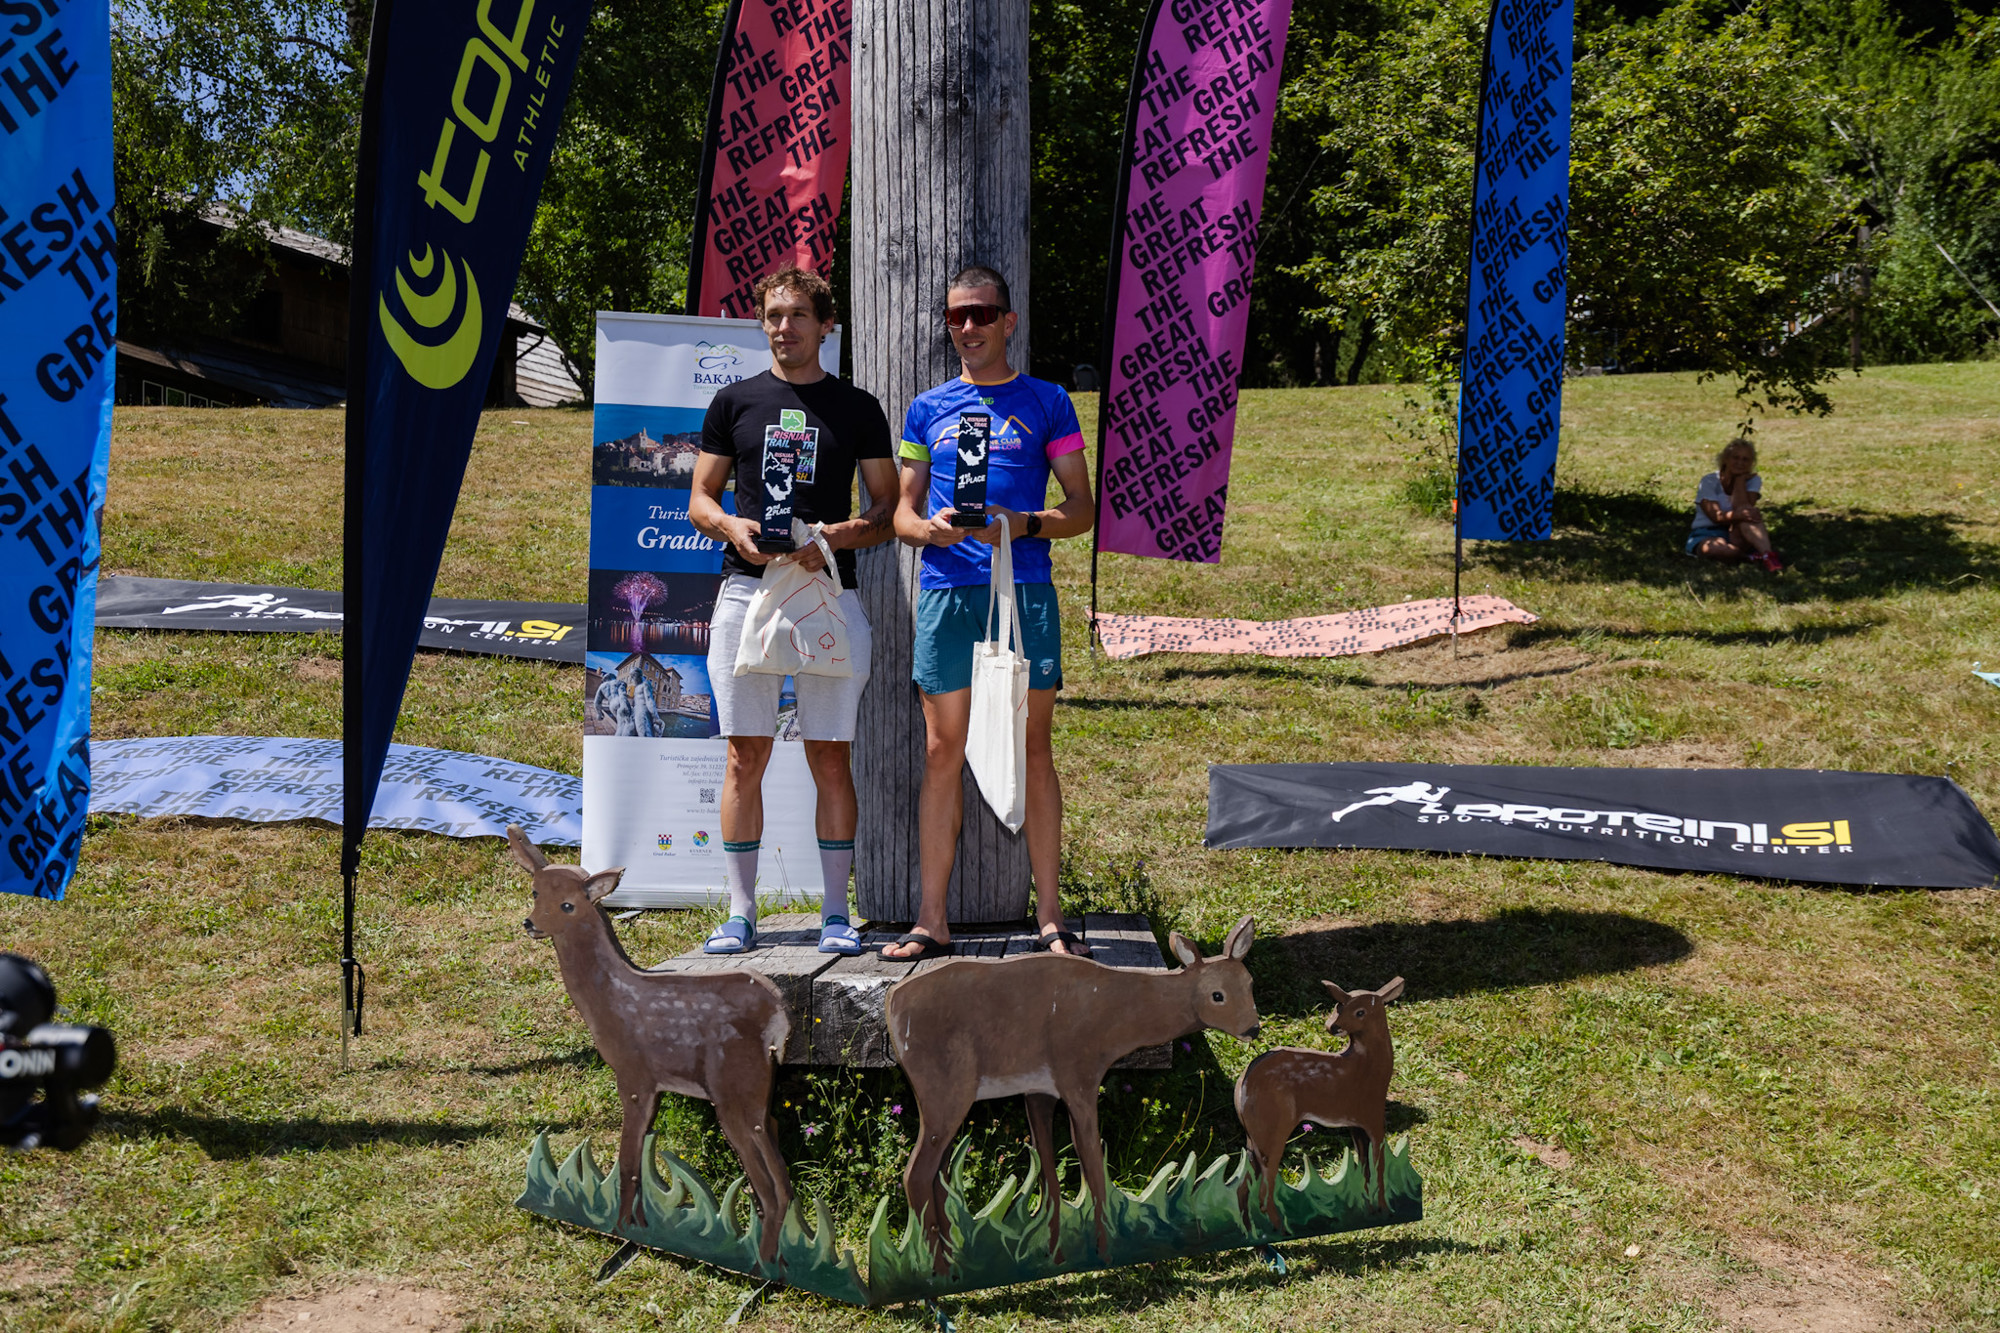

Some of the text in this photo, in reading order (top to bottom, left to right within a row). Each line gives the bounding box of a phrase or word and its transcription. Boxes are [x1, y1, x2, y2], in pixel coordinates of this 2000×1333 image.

[799, 0, 852, 51] THE
[1213, 11, 1271, 64] THE
[1522, 26, 1555, 73] THE
[513, 15, 566, 173] ATHLETIC
[727, 49, 784, 101] THE
[1140, 65, 1197, 118] THE
[1193, 39, 1275, 116] GREAT
[1485, 70, 1515, 118] THE
[1511, 50, 1565, 120] GREAT
[726, 78, 841, 177] REFRESH
[786, 117, 838, 171] THE
[1140, 88, 1261, 191] REFRESH
[1202, 127, 1259, 180] THE
[1484, 96, 1558, 188] REFRESH
[1515, 130, 1561, 180] THE
[709, 176, 758, 228] THE
[713, 185, 792, 256] GREAT
[1124, 191, 1172, 242] THE
[1473, 189, 1501, 237] THE
[725, 192, 834, 285] REFRESH
[1129, 196, 1210, 269] GREAT
[1140, 199, 1254, 298] REFRESH
[1475, 196, 1525, 265] GREAT
[1481, 193, 1566, 290] REFRESH
[1134, 284, 1190, 334] THE
[1478, 278, 1515, 325] THE
[1119, 309, 1197, 381] GREAT
[1468, 300, 1527, 371] GREAT
[1522, 333, 1564, 383] THE
[1106, 336, 1210, 430] REFRESH
[1186, 350, 1237, 400] THE
[1464, 323, 1544, 416] EFRESH
[773, 430, 812, 442] RISNJAK
[1114, 400, 1168, 449] THE
[1464, 389, 1508, 438] THE
[1104, 425, 1177, 494] GREAT
[1462, 411, 1519, 477] REAT
[1462, 411, 1555, 507] REFRESH
[1109, 430, 1221, 521] REFRESH
[1484, 466, 1530, 514] THE
[1498, 461, 1555, 534] GREAT
[1137, 484, 1191, 531] THE
[1155, 484, 1228, 552] GREAT
[637, 526, 714, 552] Grada
[469, 631, 559, 646] CENTER
[168, 753, 236, 766] THE
[219, 769, 333, 783] GREAT
[264, 756, 331, 769] THE
[381, 771, 492, 796] GREAT
[152, 790, 224, 804] THE
[413, 786, 569, 825] REFRESH
[519, 784, 582, 801] THE
[1535, 821, 1709, 848] NUTRITION
[1731, 843, 1854, 855] CENTER
